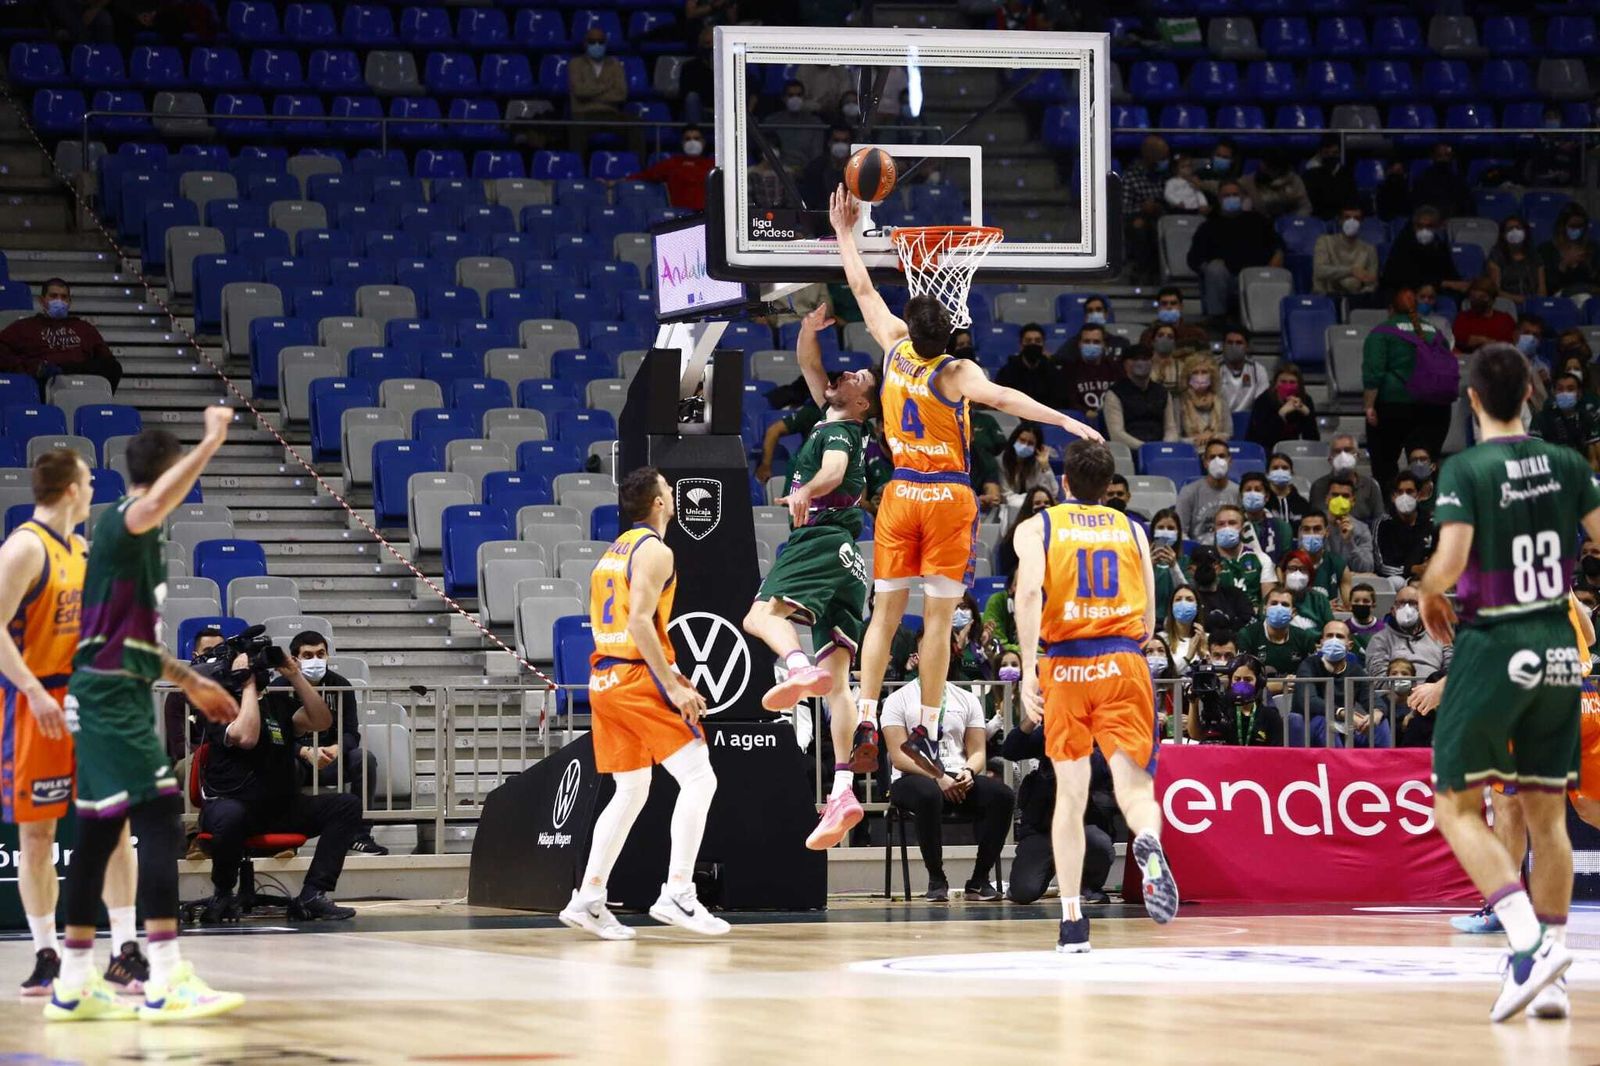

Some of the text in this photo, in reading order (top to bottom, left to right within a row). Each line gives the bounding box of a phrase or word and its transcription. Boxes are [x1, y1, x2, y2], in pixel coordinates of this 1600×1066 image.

[753, 217, 771, 228] liga
[753, 228, 795, 238] endesa
[901, 398, 924, 439] 4
[685, 508, 711, 517] Unicaja
[1068, 512, 1116, 528] TOBEY
[1076, 548, 1119, 598] 10
[1512, 530, 1564, 603] 83
[602, 578, 615, 624] 2
[730, 734, 776, 751] agen
[34, 778, 71, 791] PULEV
[1162, 763, 1436, 837] endes
[555, 831, 571, 848] Wagen
